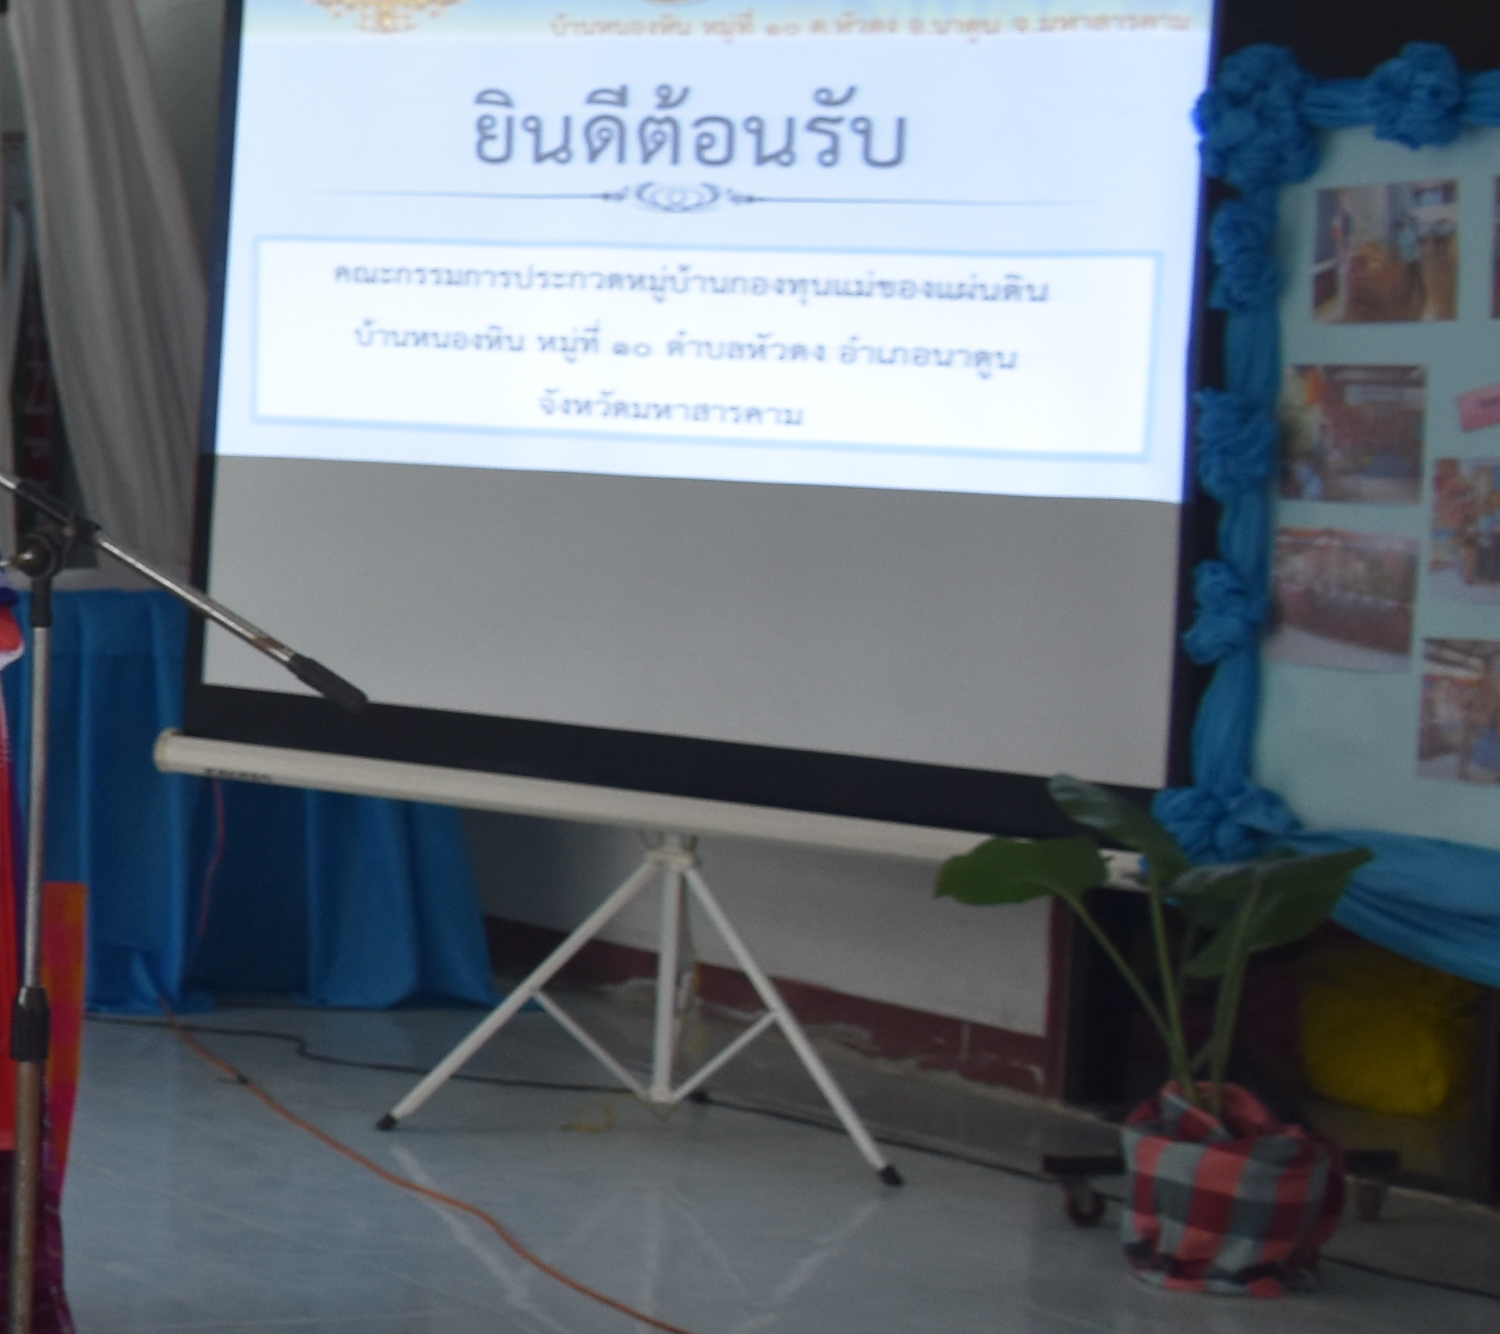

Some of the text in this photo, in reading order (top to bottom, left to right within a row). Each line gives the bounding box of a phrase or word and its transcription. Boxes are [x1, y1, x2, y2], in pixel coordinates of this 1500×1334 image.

[474, 83, 908, 169] ยินดีต้อนรับ
[333, 259, 1050, 305] คณะกรรมการประกวดหมู่บ้านกองทุนแม่ของแผ่นดิน
[354, 318, 1019, 379] บ้านหนองหิน หมู่ที่ ๑๐ ตำบลหัวดง อำเภอนาดูน
[538, 388, 805, 427] จังหวัดมหาสารคาม
